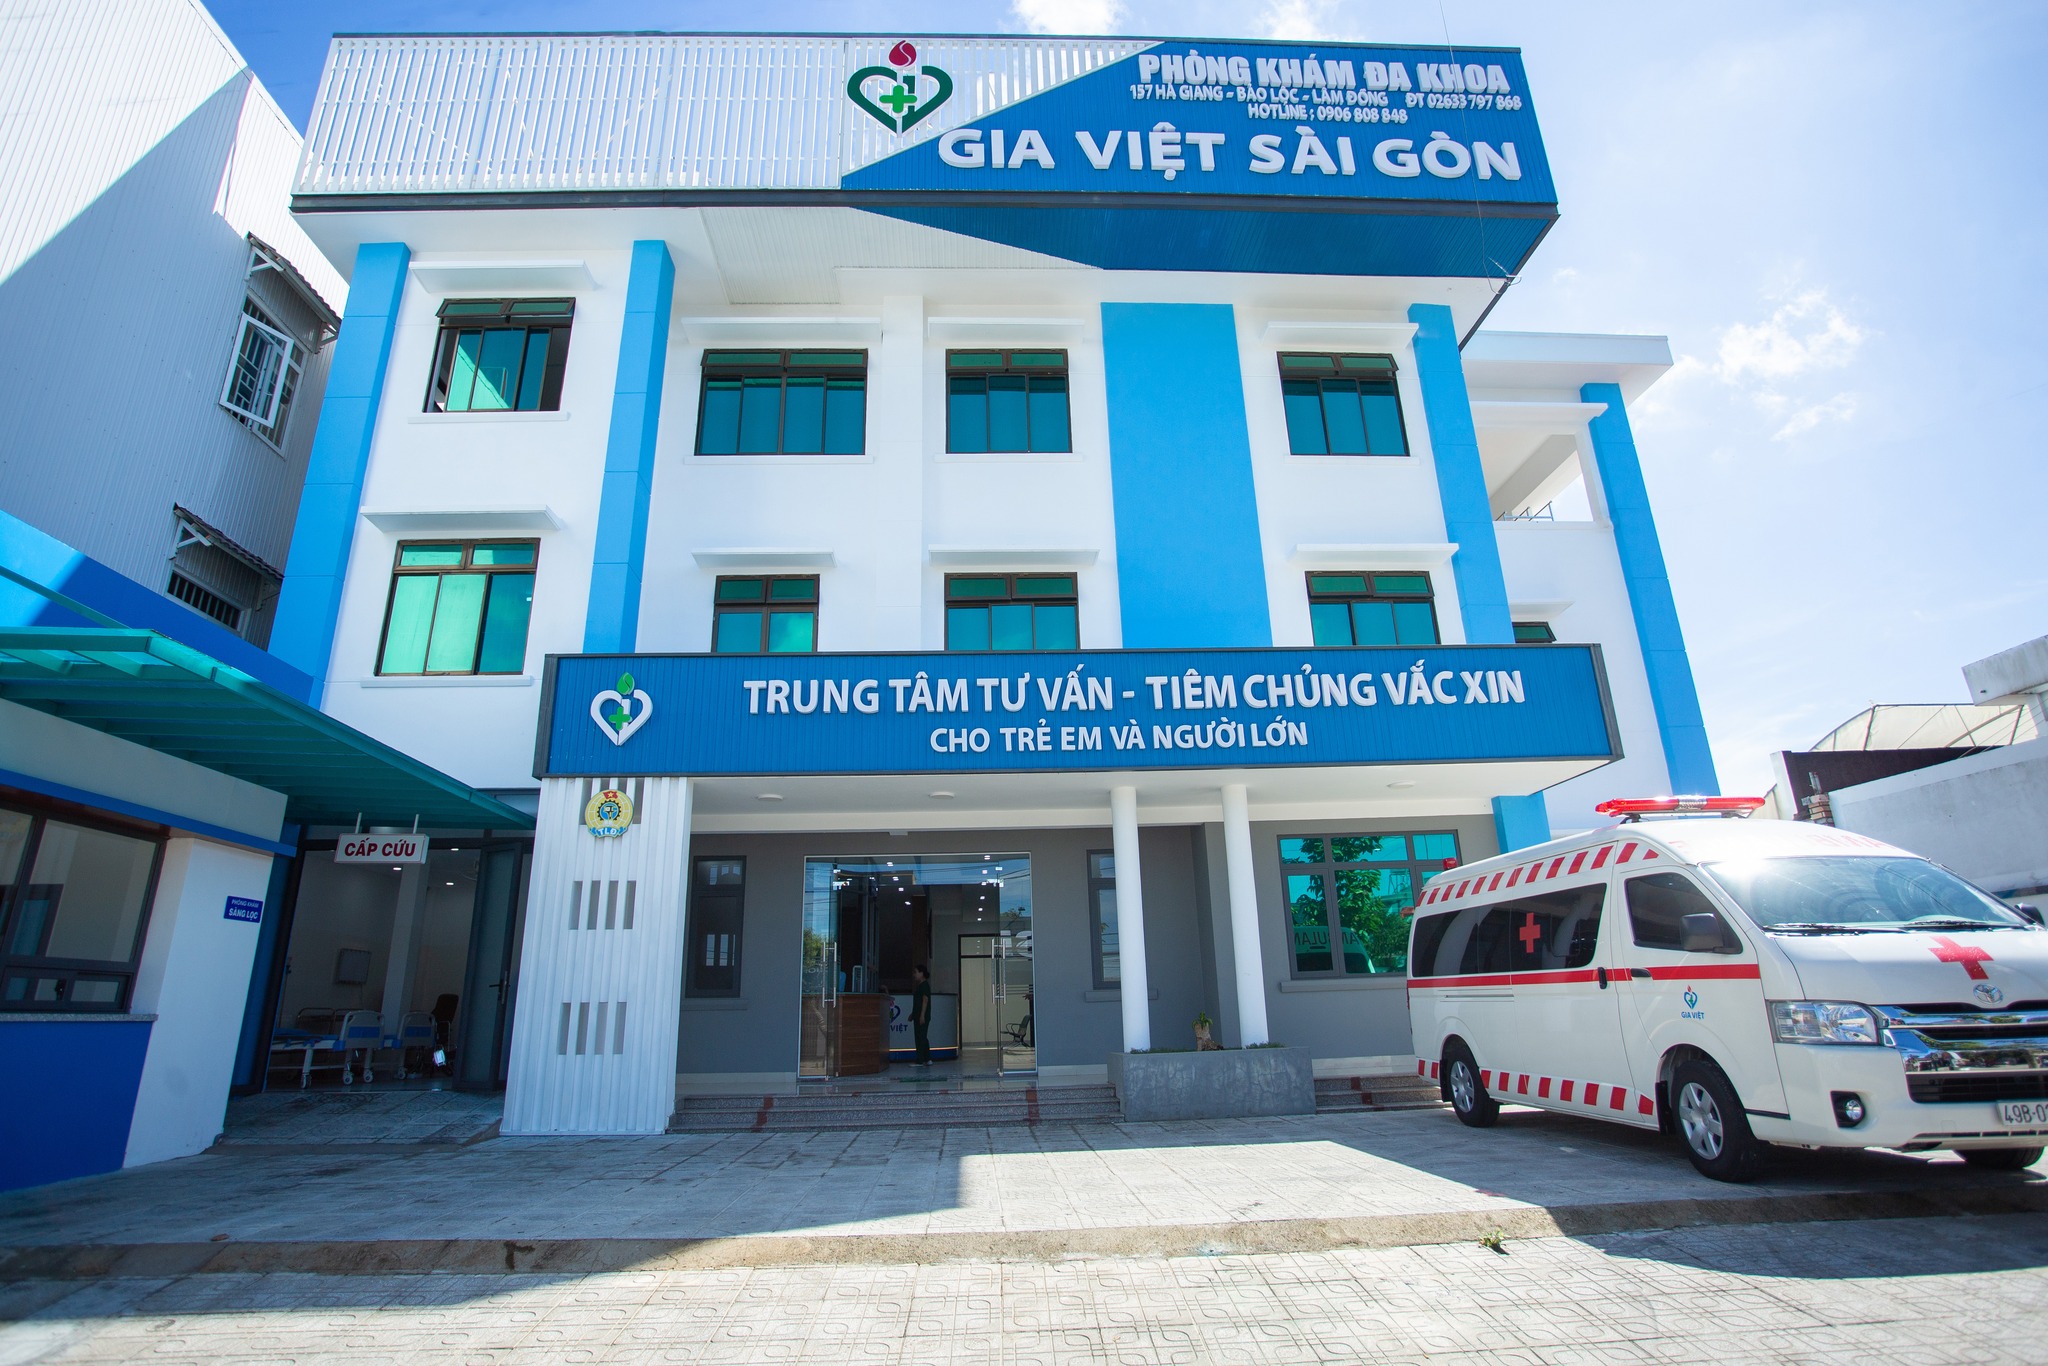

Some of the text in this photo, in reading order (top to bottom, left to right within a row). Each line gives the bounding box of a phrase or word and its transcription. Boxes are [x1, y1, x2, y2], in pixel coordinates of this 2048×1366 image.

[1138, 49, 1511, 95] PHÒNG KHÁM ĐA KHOA
[1130, 84, 1153, 101] 157
[1179, 84, 1224, 103] GIANG
[1270, 86, 1300, 106] LỘC
[1312, 87, 1344, 107] LÂM
[1405, 91, 1425, 109] ĐT
[1427, 93, 1467, 110] 02633
[1468, 95, 1493, 110] 797
[1495, 95, 1522, 111] 868
[1248, 102, 1308, 120] HOTLINE
[1317, 105, 1352, 123] 0906
[1354, 107, 1380, 124] 808
[1382, 108, 1408, 125] 848
[938, 121, 1522, 181] GIA VIỆT SÀI GÒN
[743, 658, 1526, 715] TRUNG TÂM TƯ VẤN - TIÊM CHỦNG VẮC XIN
[930, 715, 1309, 753] CHO TRẺ EM VÀ NGƯỜI LỚN
[344, 837, 417, 857] CẤP CỨU
[1681, 1010, 1705, 1020] GIA VIỆT
